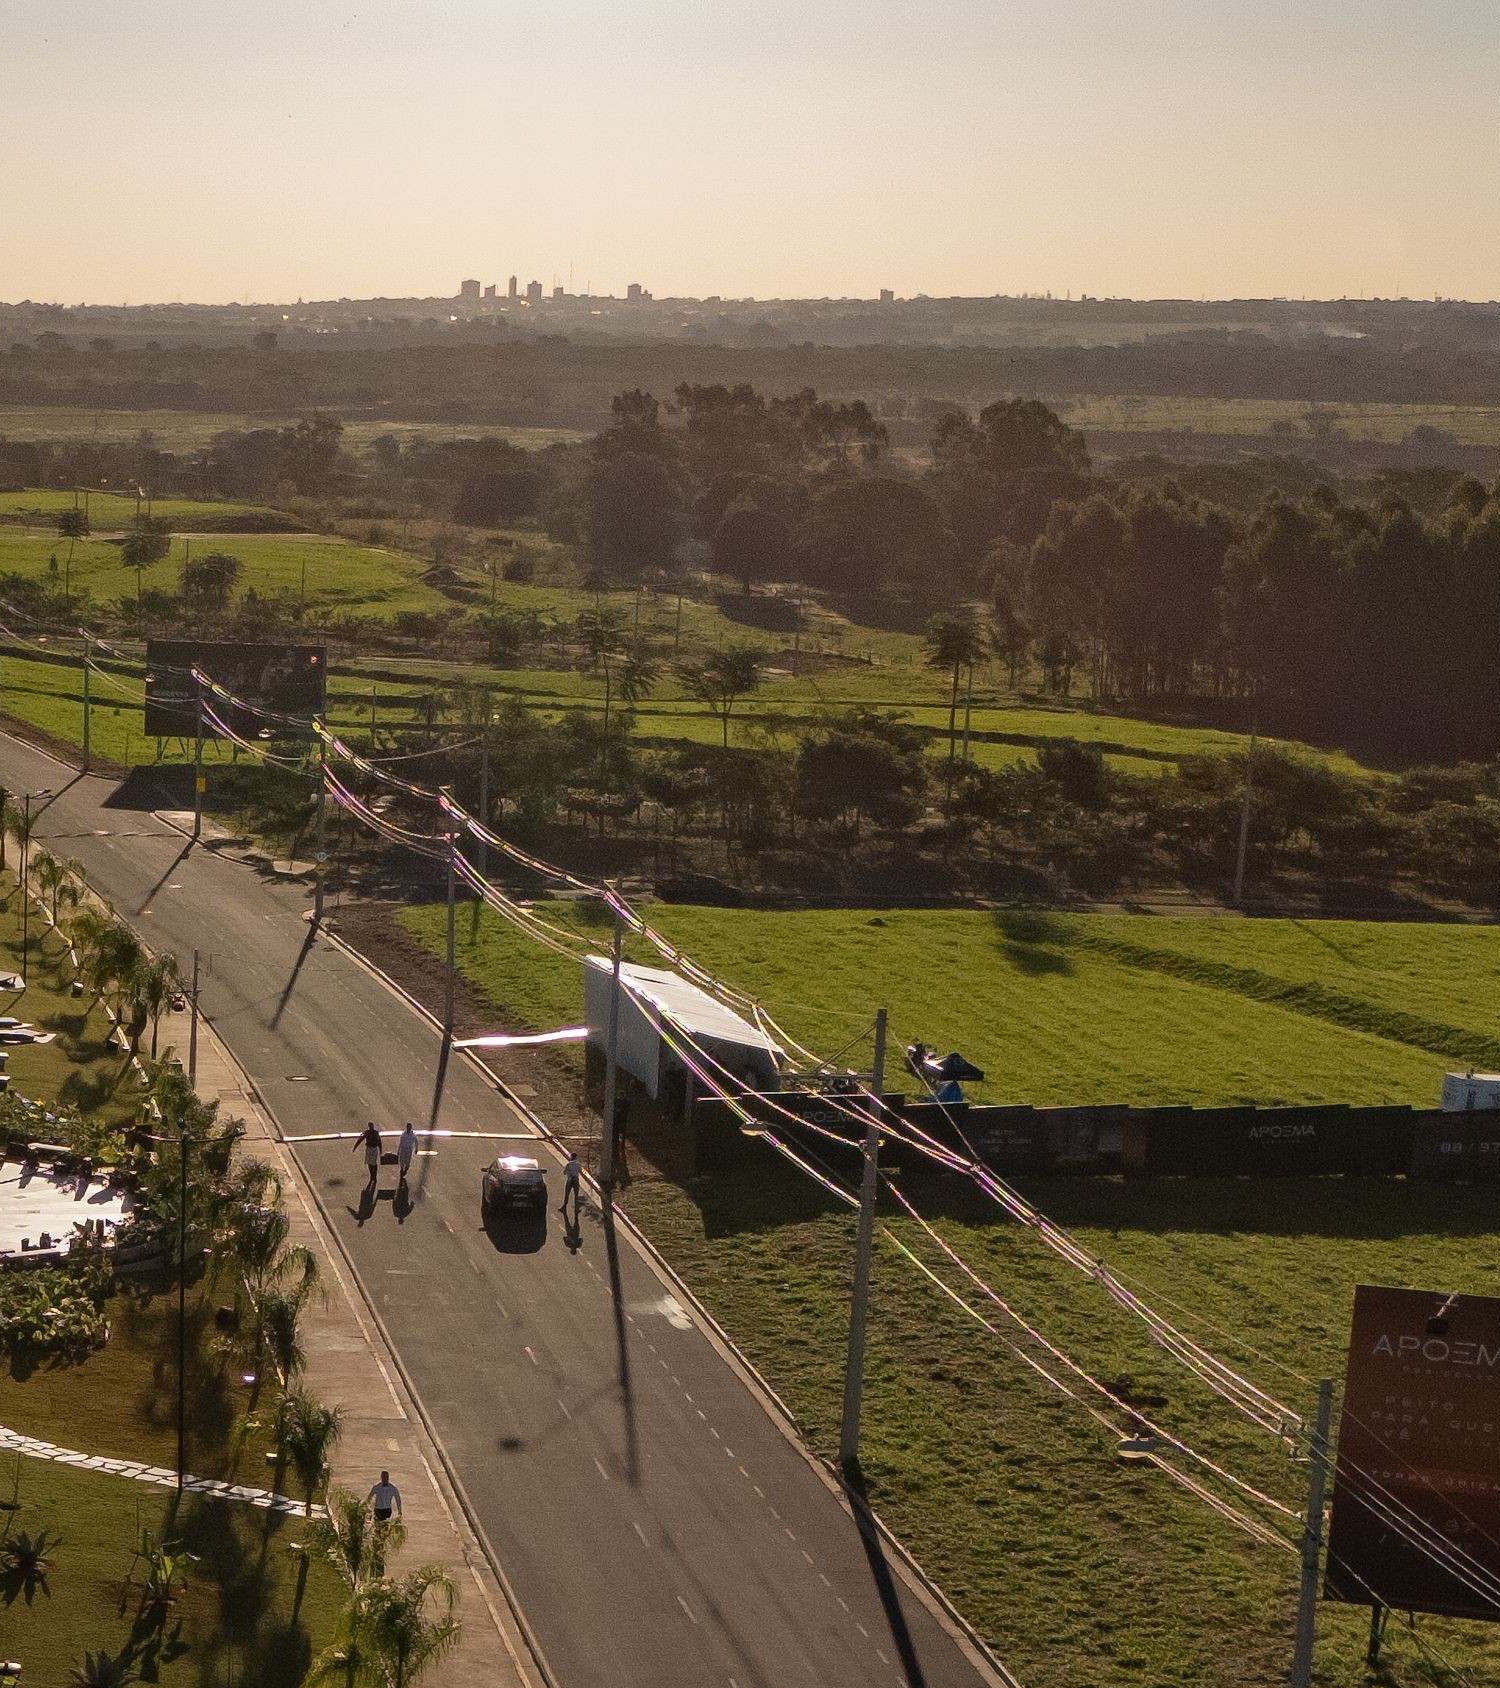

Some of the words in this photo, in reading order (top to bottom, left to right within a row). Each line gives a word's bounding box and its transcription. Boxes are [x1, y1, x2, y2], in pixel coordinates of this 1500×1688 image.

[1248, 1123, 1317, 1140] APOEMA
[1385, 1395, 1455, 1413] FEITO
[1370, 1410, 1430, 1427] PARA
